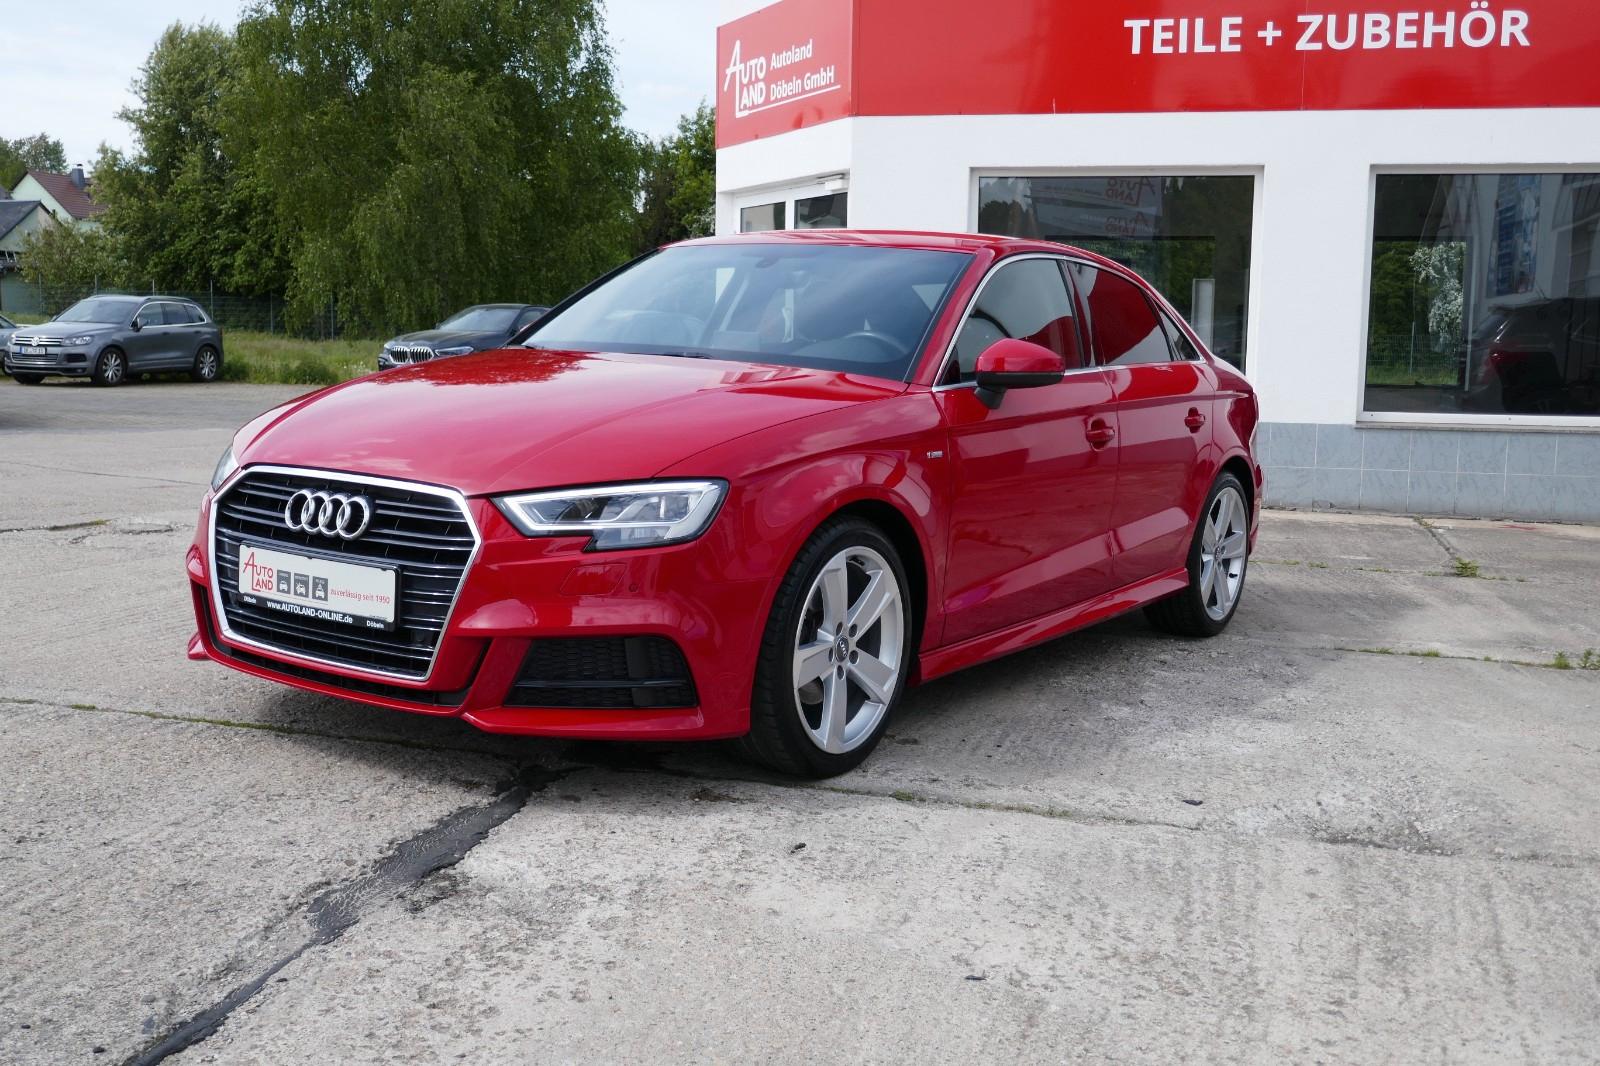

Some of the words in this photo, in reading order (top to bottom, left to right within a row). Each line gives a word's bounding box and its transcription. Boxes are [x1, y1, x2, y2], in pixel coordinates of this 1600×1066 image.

[1123, 16, 1243, 55] TEILE
[1257, 21, 1282, 46] +
[1295, 1, 1531, 51] ZUBEHÖR
[724, 40, 767, 92] AUTO
[770, 38, 813, 71] Autoland
[736, 81, 767, 118] LAND
[770, 76, 802, 101] Döbeln
[804, 65, 835, 90] GmbH
[243, 552, 274, 578] AUTO
[252, 578, 274, 592] LAND
[267, 601, 353, 624] www.AUTOLAND-ONLINE.de
